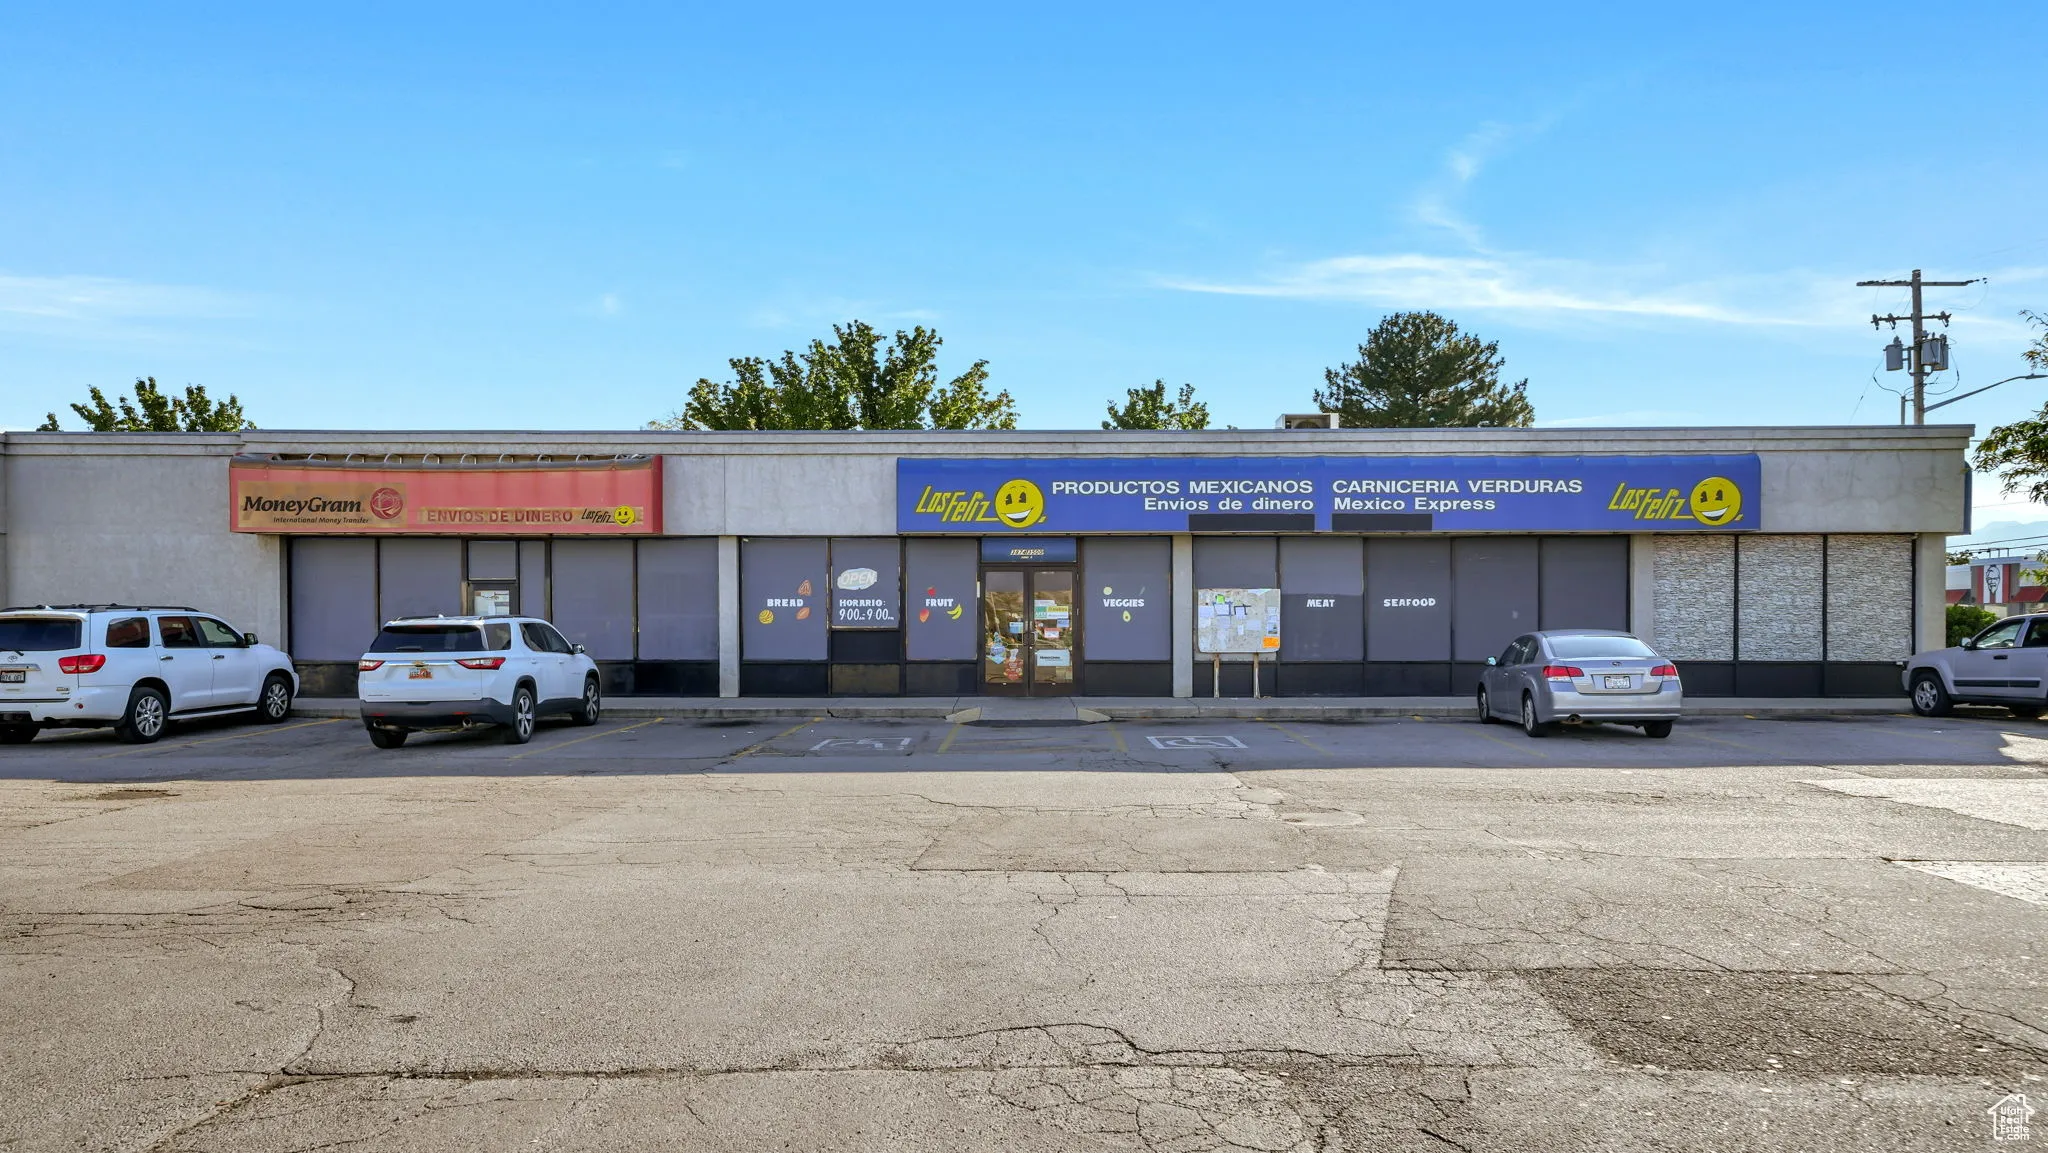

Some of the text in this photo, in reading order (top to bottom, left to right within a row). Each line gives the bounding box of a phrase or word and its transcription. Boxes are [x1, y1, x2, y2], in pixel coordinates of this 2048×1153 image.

[1052, 480, 1313, 495] PRODUCTOS MEXICANOS
[1332, 479, 1583, 494] CARNICERIA VERDURAS
[243, 496, 361, 515] MoneyGram
[1144, 497, 1314, 510] Envios de dinero
[1334, 497, 1495, 512] Mexico Express
[318, 517, 341, 525] Money
[427, 510, 573, 522] ENVIOS DE DINERO
[840, 570, 877, 585] OPEN
[766, 598, 804, 607] BREAD
[839, 599, 886, 607] HORARIO:
[925, 598, 954, 607] FRUIT
[1102, 598, 1145, 608] VEGGIES
[1306, 599, 1336, 608] MEAT
[1383, 598, 1436, 607] SEAFOOD
